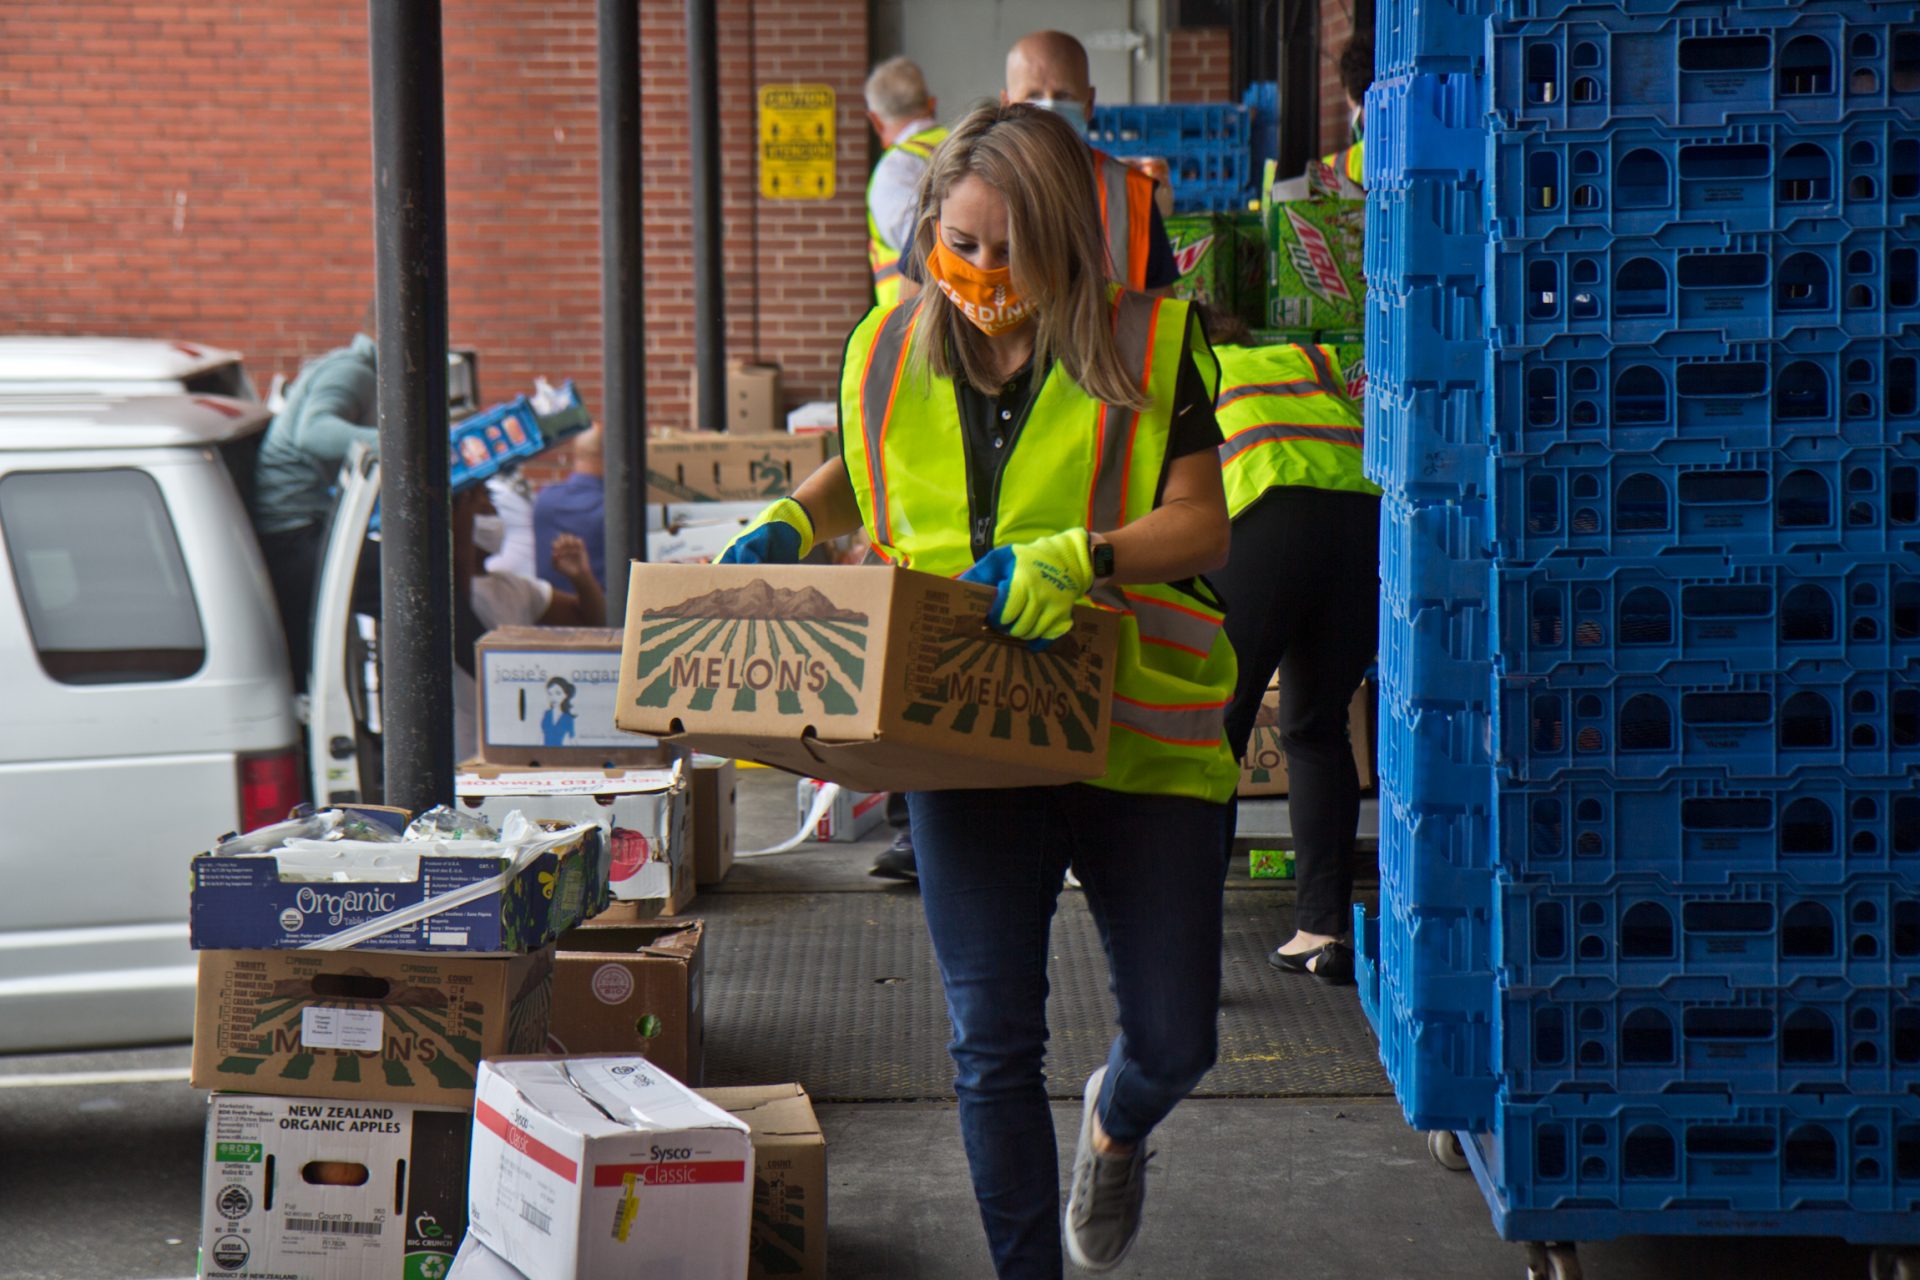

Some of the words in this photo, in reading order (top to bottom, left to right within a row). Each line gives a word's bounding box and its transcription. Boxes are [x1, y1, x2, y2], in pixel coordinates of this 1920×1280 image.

[938, 279, 1038, 322] FEEDIN
[494, 664, 547, 684] josie's
[671, 656, 828, 692] MELONS
[950, 671, 1069, 719] MELONS
[296, 886, 396, 927] Organic
[274, 1028, 437, 1062] MNS
[288, 1105, 323, 1117] NEW
[327, 1106, 393, 1120] ZEALAND
[514, 1107, 529, 1129] Sysco
[279, 1118, 345, 1132] ORGANIC
[350, 1121, 401, 1134] APPLES
[509, 1126, 528, 1154] Classic
[650, 1145, 692, 1163] Sysco
[643, 1164, 697, 1185] Classic
[318, 1211, 342, 1221] Count
[342, 1213, 353, 1221] 70
[373, 1215, 386, 1223] AC
[421, 1239, 453, 1247] CRUNCH
